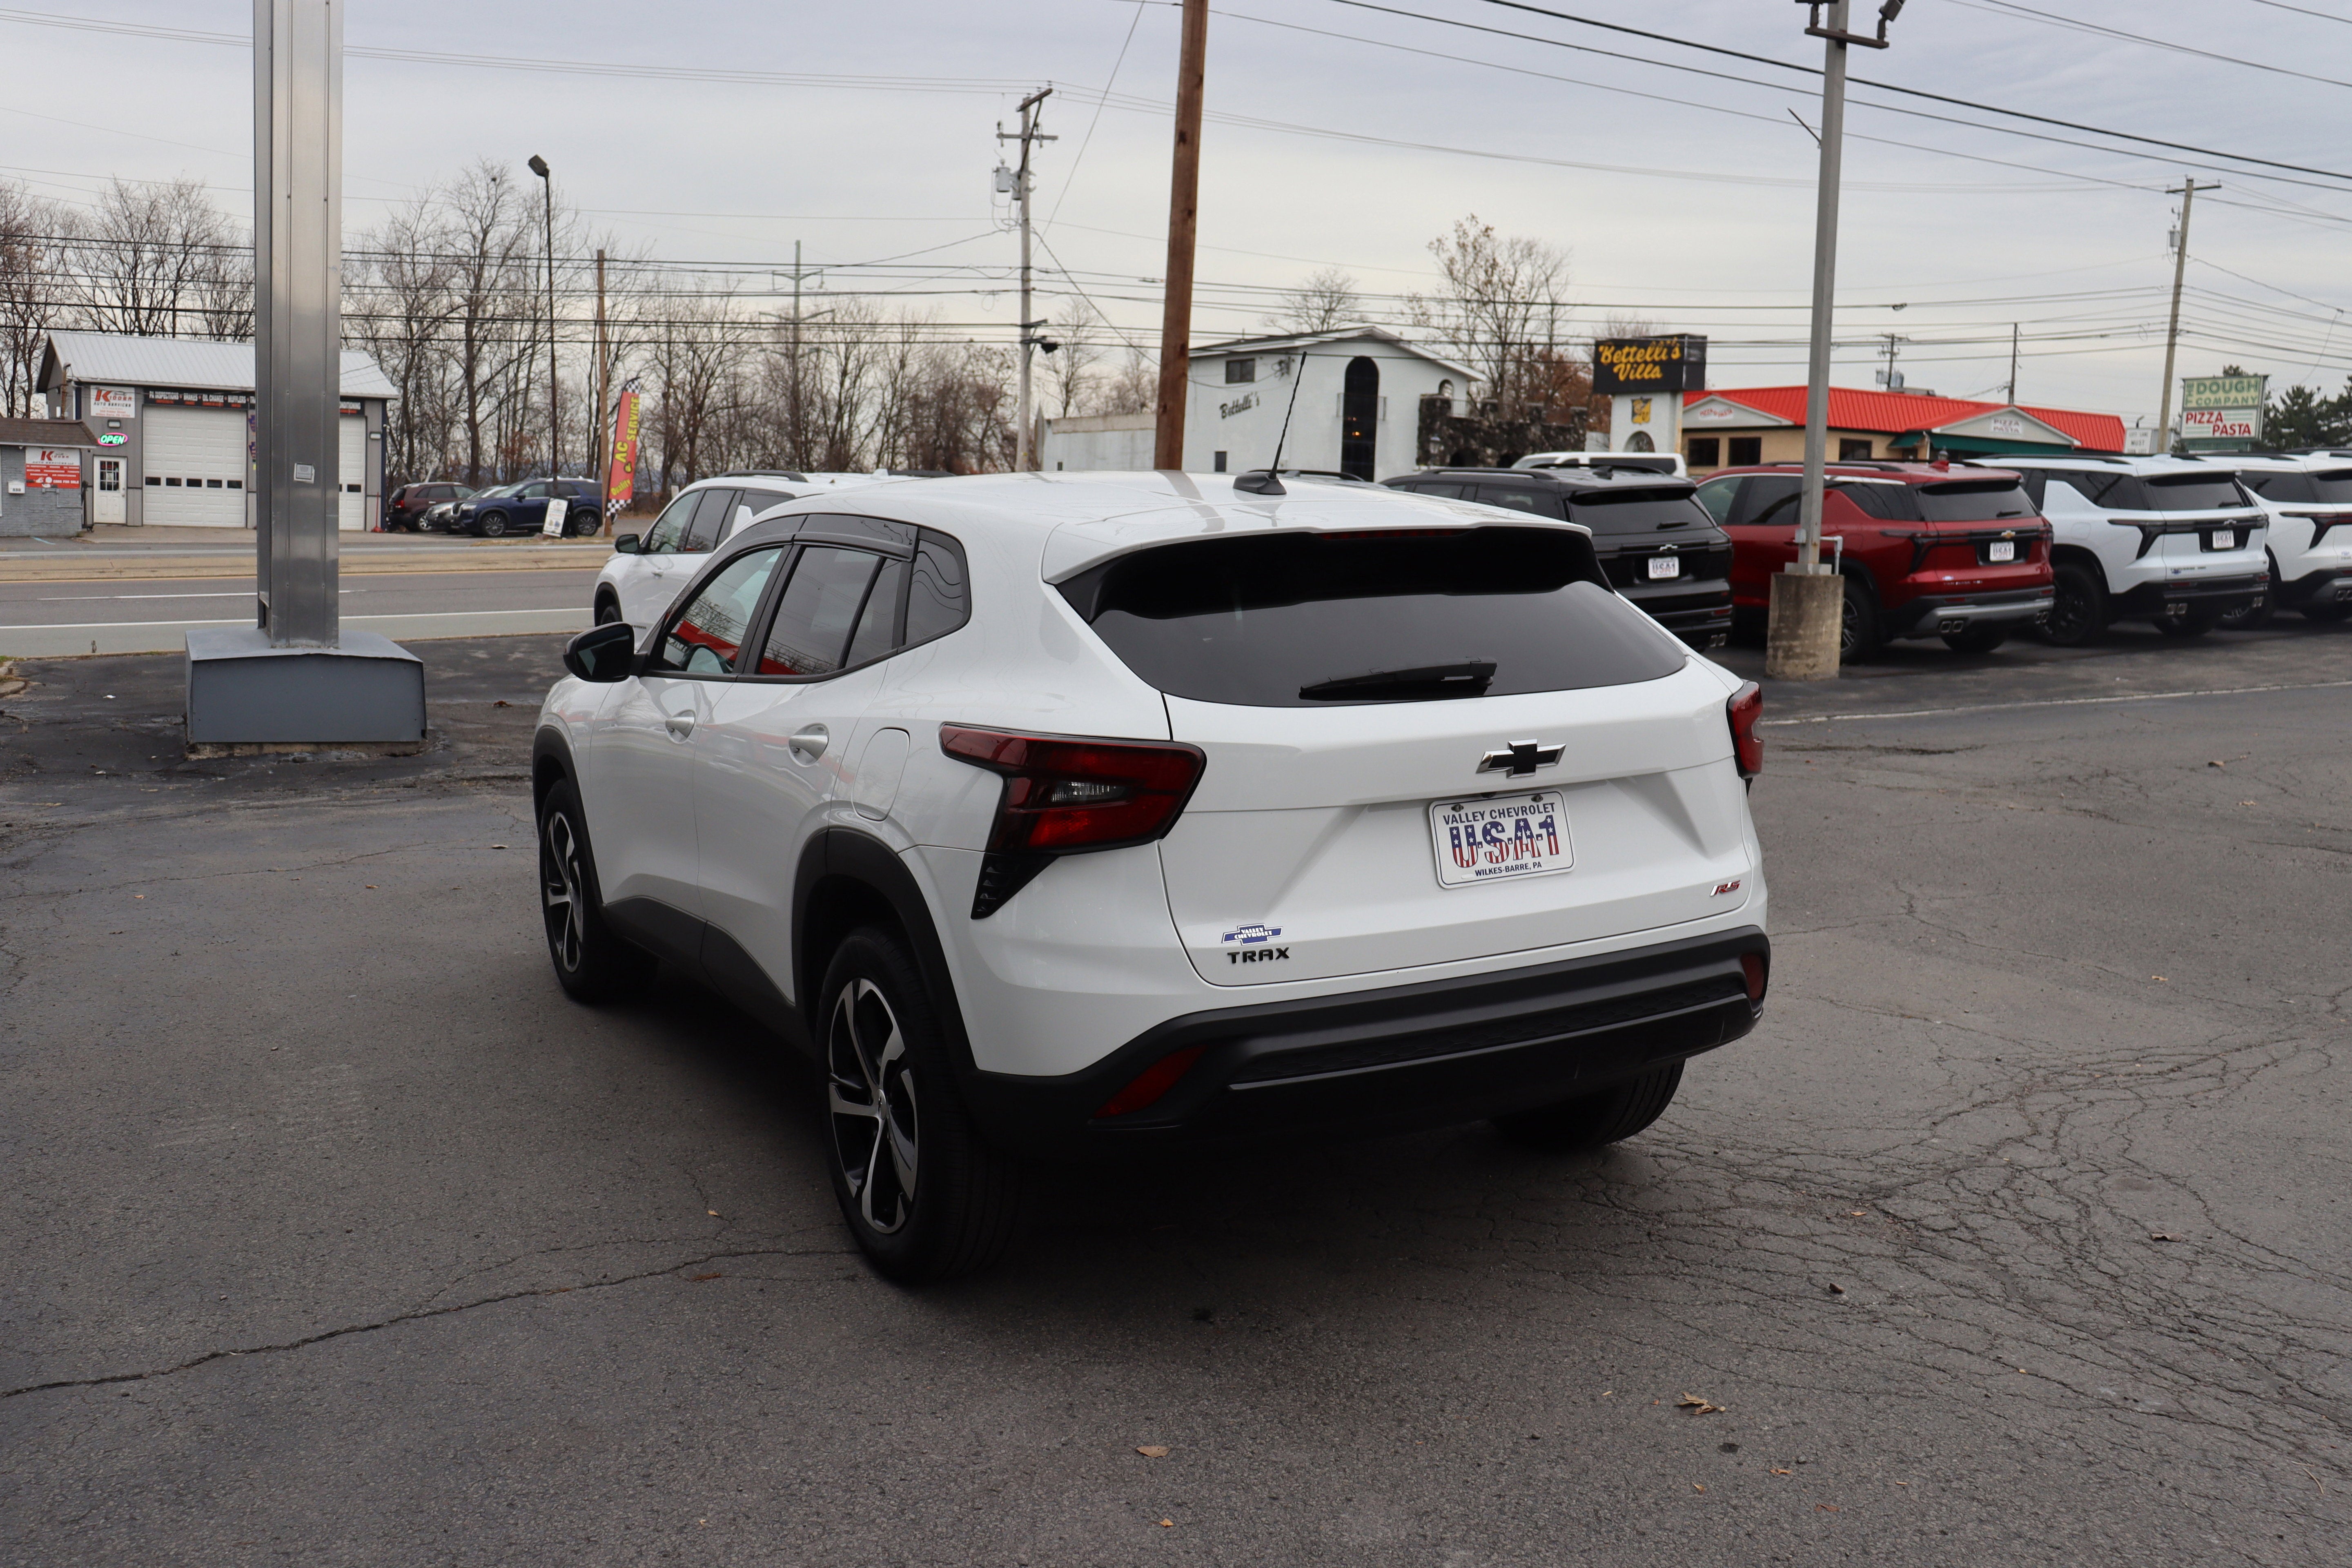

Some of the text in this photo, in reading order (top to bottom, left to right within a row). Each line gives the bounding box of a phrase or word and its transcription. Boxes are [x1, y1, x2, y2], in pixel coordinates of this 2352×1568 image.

[1599, 337, 1681, 363] Bettelli's
[1613, 363, 1663, 381] Villa
[2196, 379, 2258, 395] DOUGH
[2195, 396, 2258, 406] COMPANY
[626, 396, 640, 441] SERVICE
[2186, 411, 2223, 424] PIZZA
[2212, 423, 2251, 436] PASTA
[100, 434, 125, 444] OPEN
[1443, 802, 1555, 825] VALLEY CHEVROLET
[1475, 863, 1531, 876] WILKES-BARRE,
[1710, 880, 1741, 897] RS
[1234, 930, 1272, 940] CHEVROLET
[1227, 947, 1290, 964] TRAX
